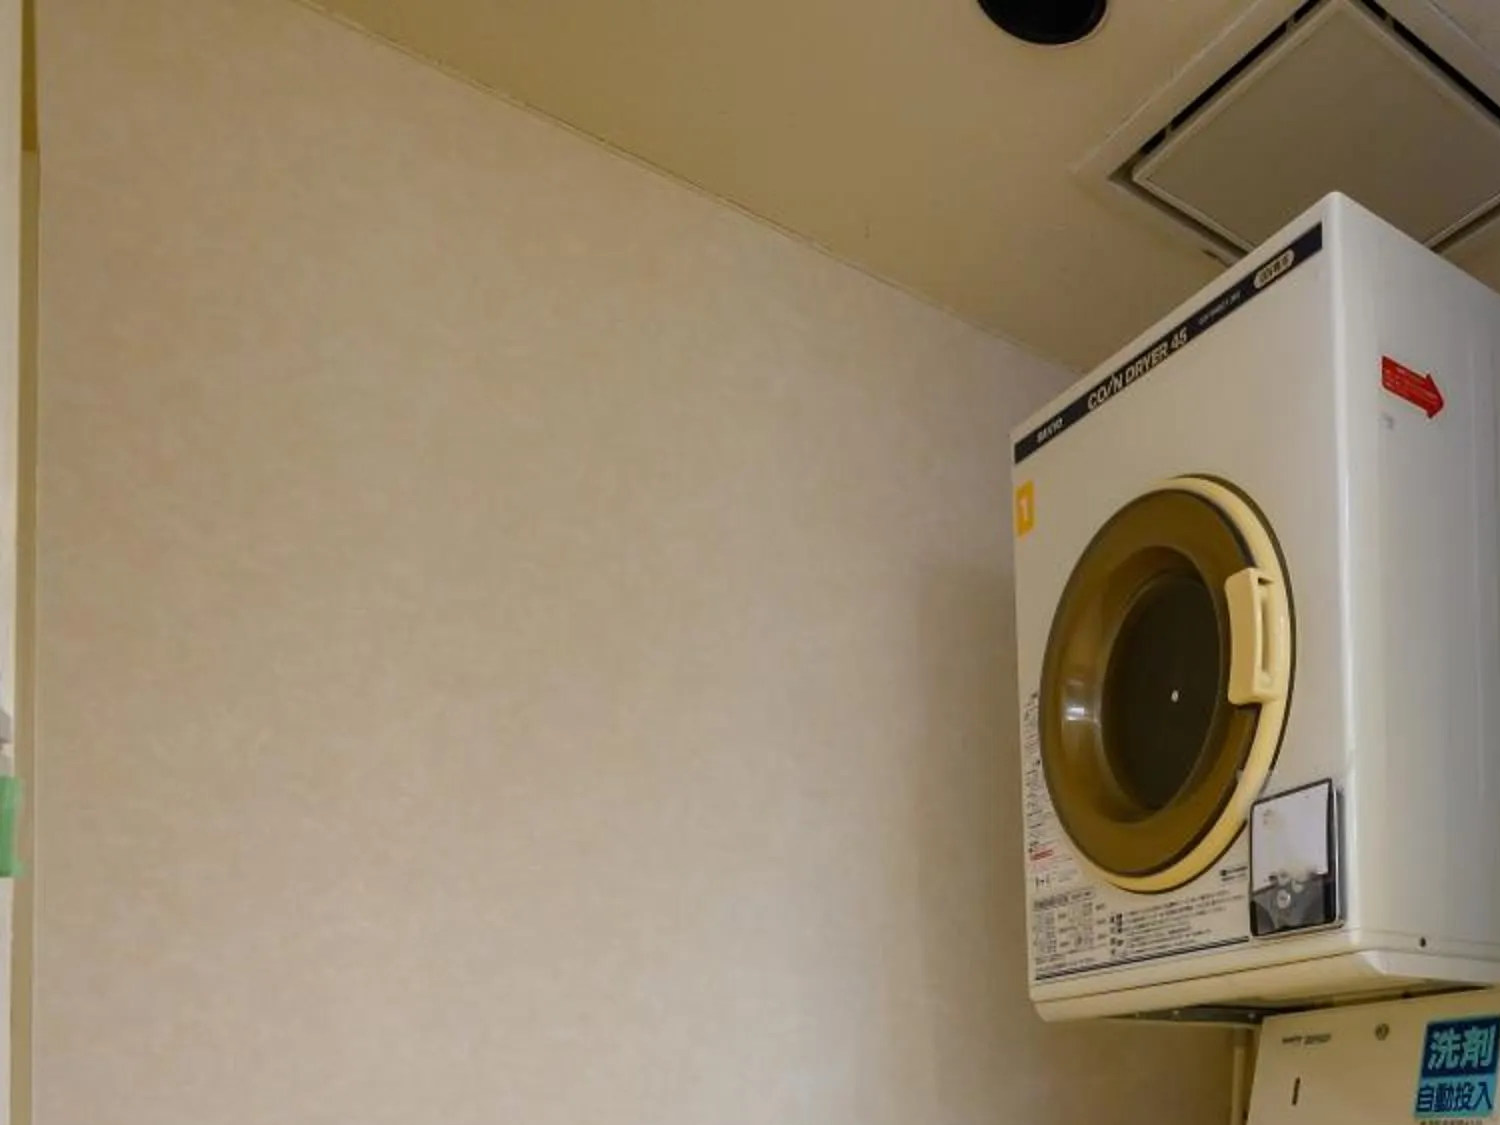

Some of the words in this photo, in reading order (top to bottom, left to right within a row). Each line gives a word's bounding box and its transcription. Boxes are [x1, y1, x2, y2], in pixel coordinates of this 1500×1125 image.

[1125, 341, 1169, 384] DRYER
[1427, 1024, 1497, 1070] 洗剤
[1416, 1081, 1494, 1112] 自動投入
